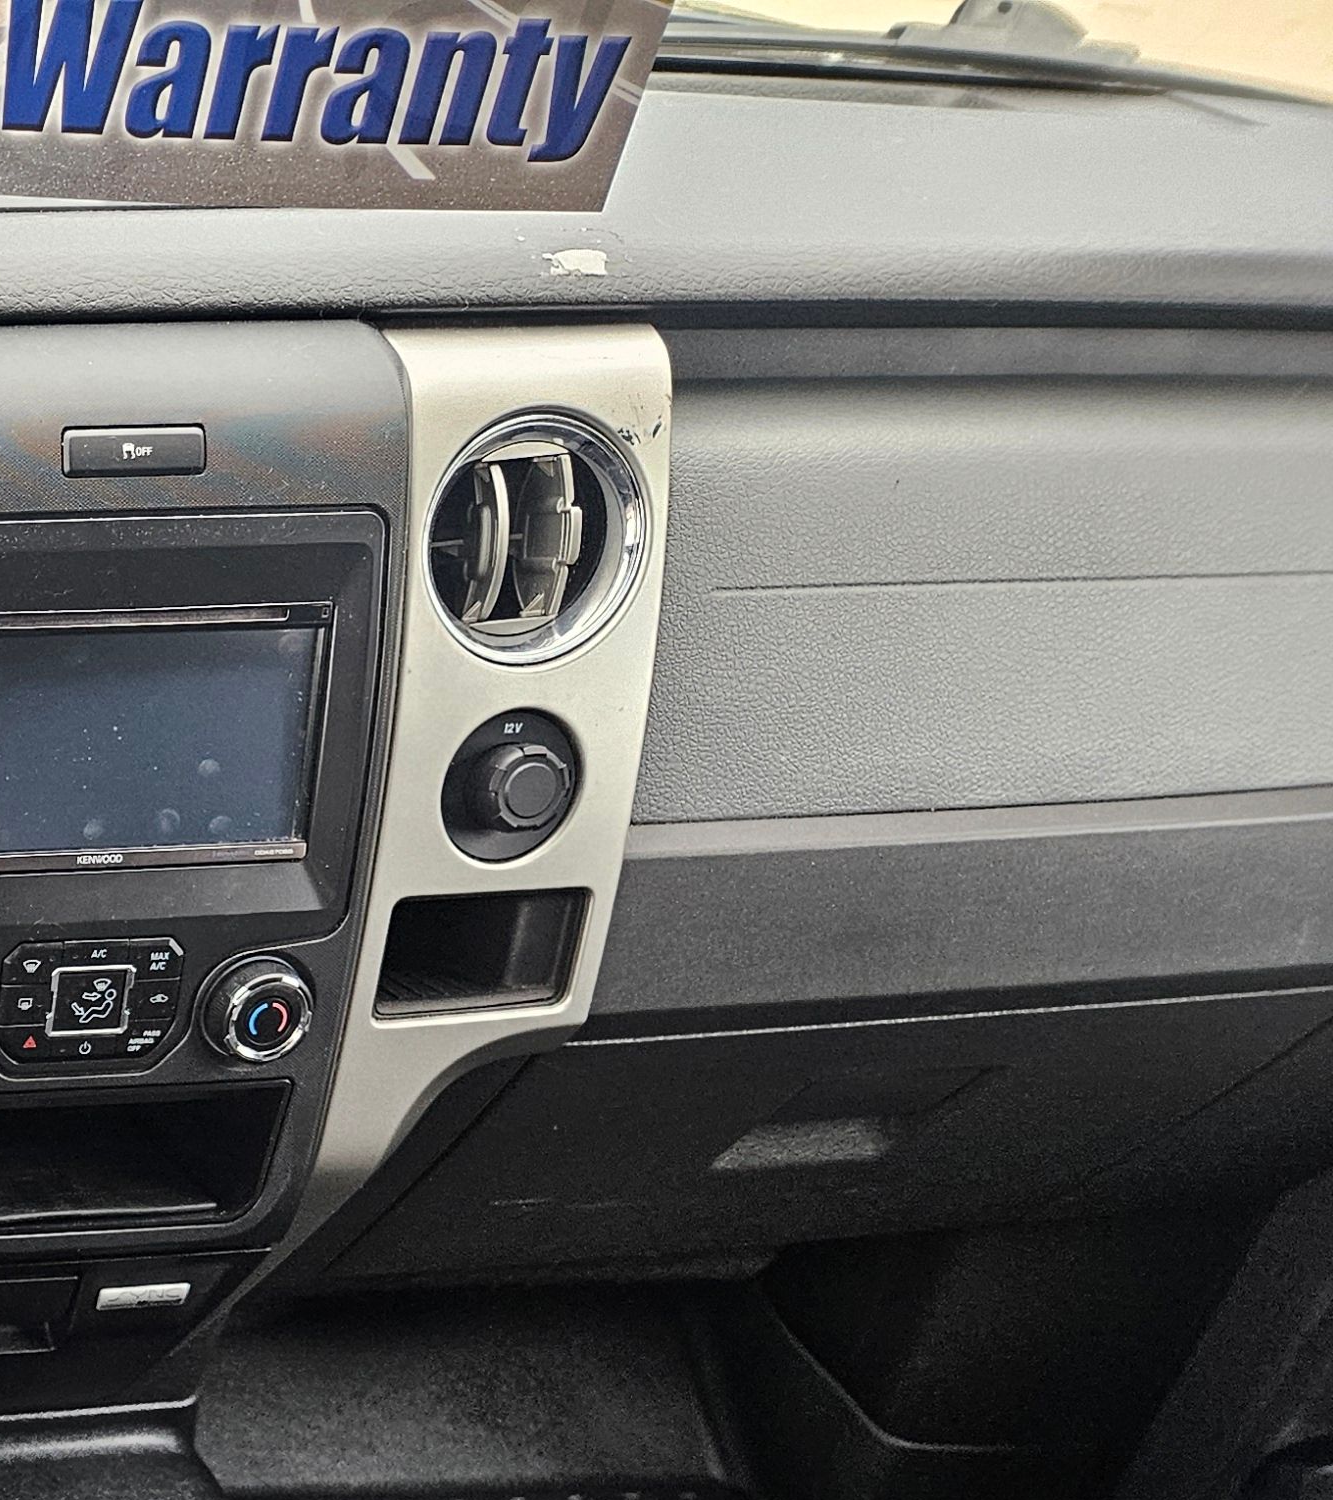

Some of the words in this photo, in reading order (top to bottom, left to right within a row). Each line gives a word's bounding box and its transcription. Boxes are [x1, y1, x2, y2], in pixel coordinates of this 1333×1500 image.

[2, 0, 631, 163] Warranty
[135, 446, 153, 457] OFF
[503, 722, 523, 734] 12V
[76, 853, 124, 865] KENWOOD
[91, 949, 107, 959] A/C
[150, 952, 170, 961] MAX
[150, 962, 166, 971] A/C
